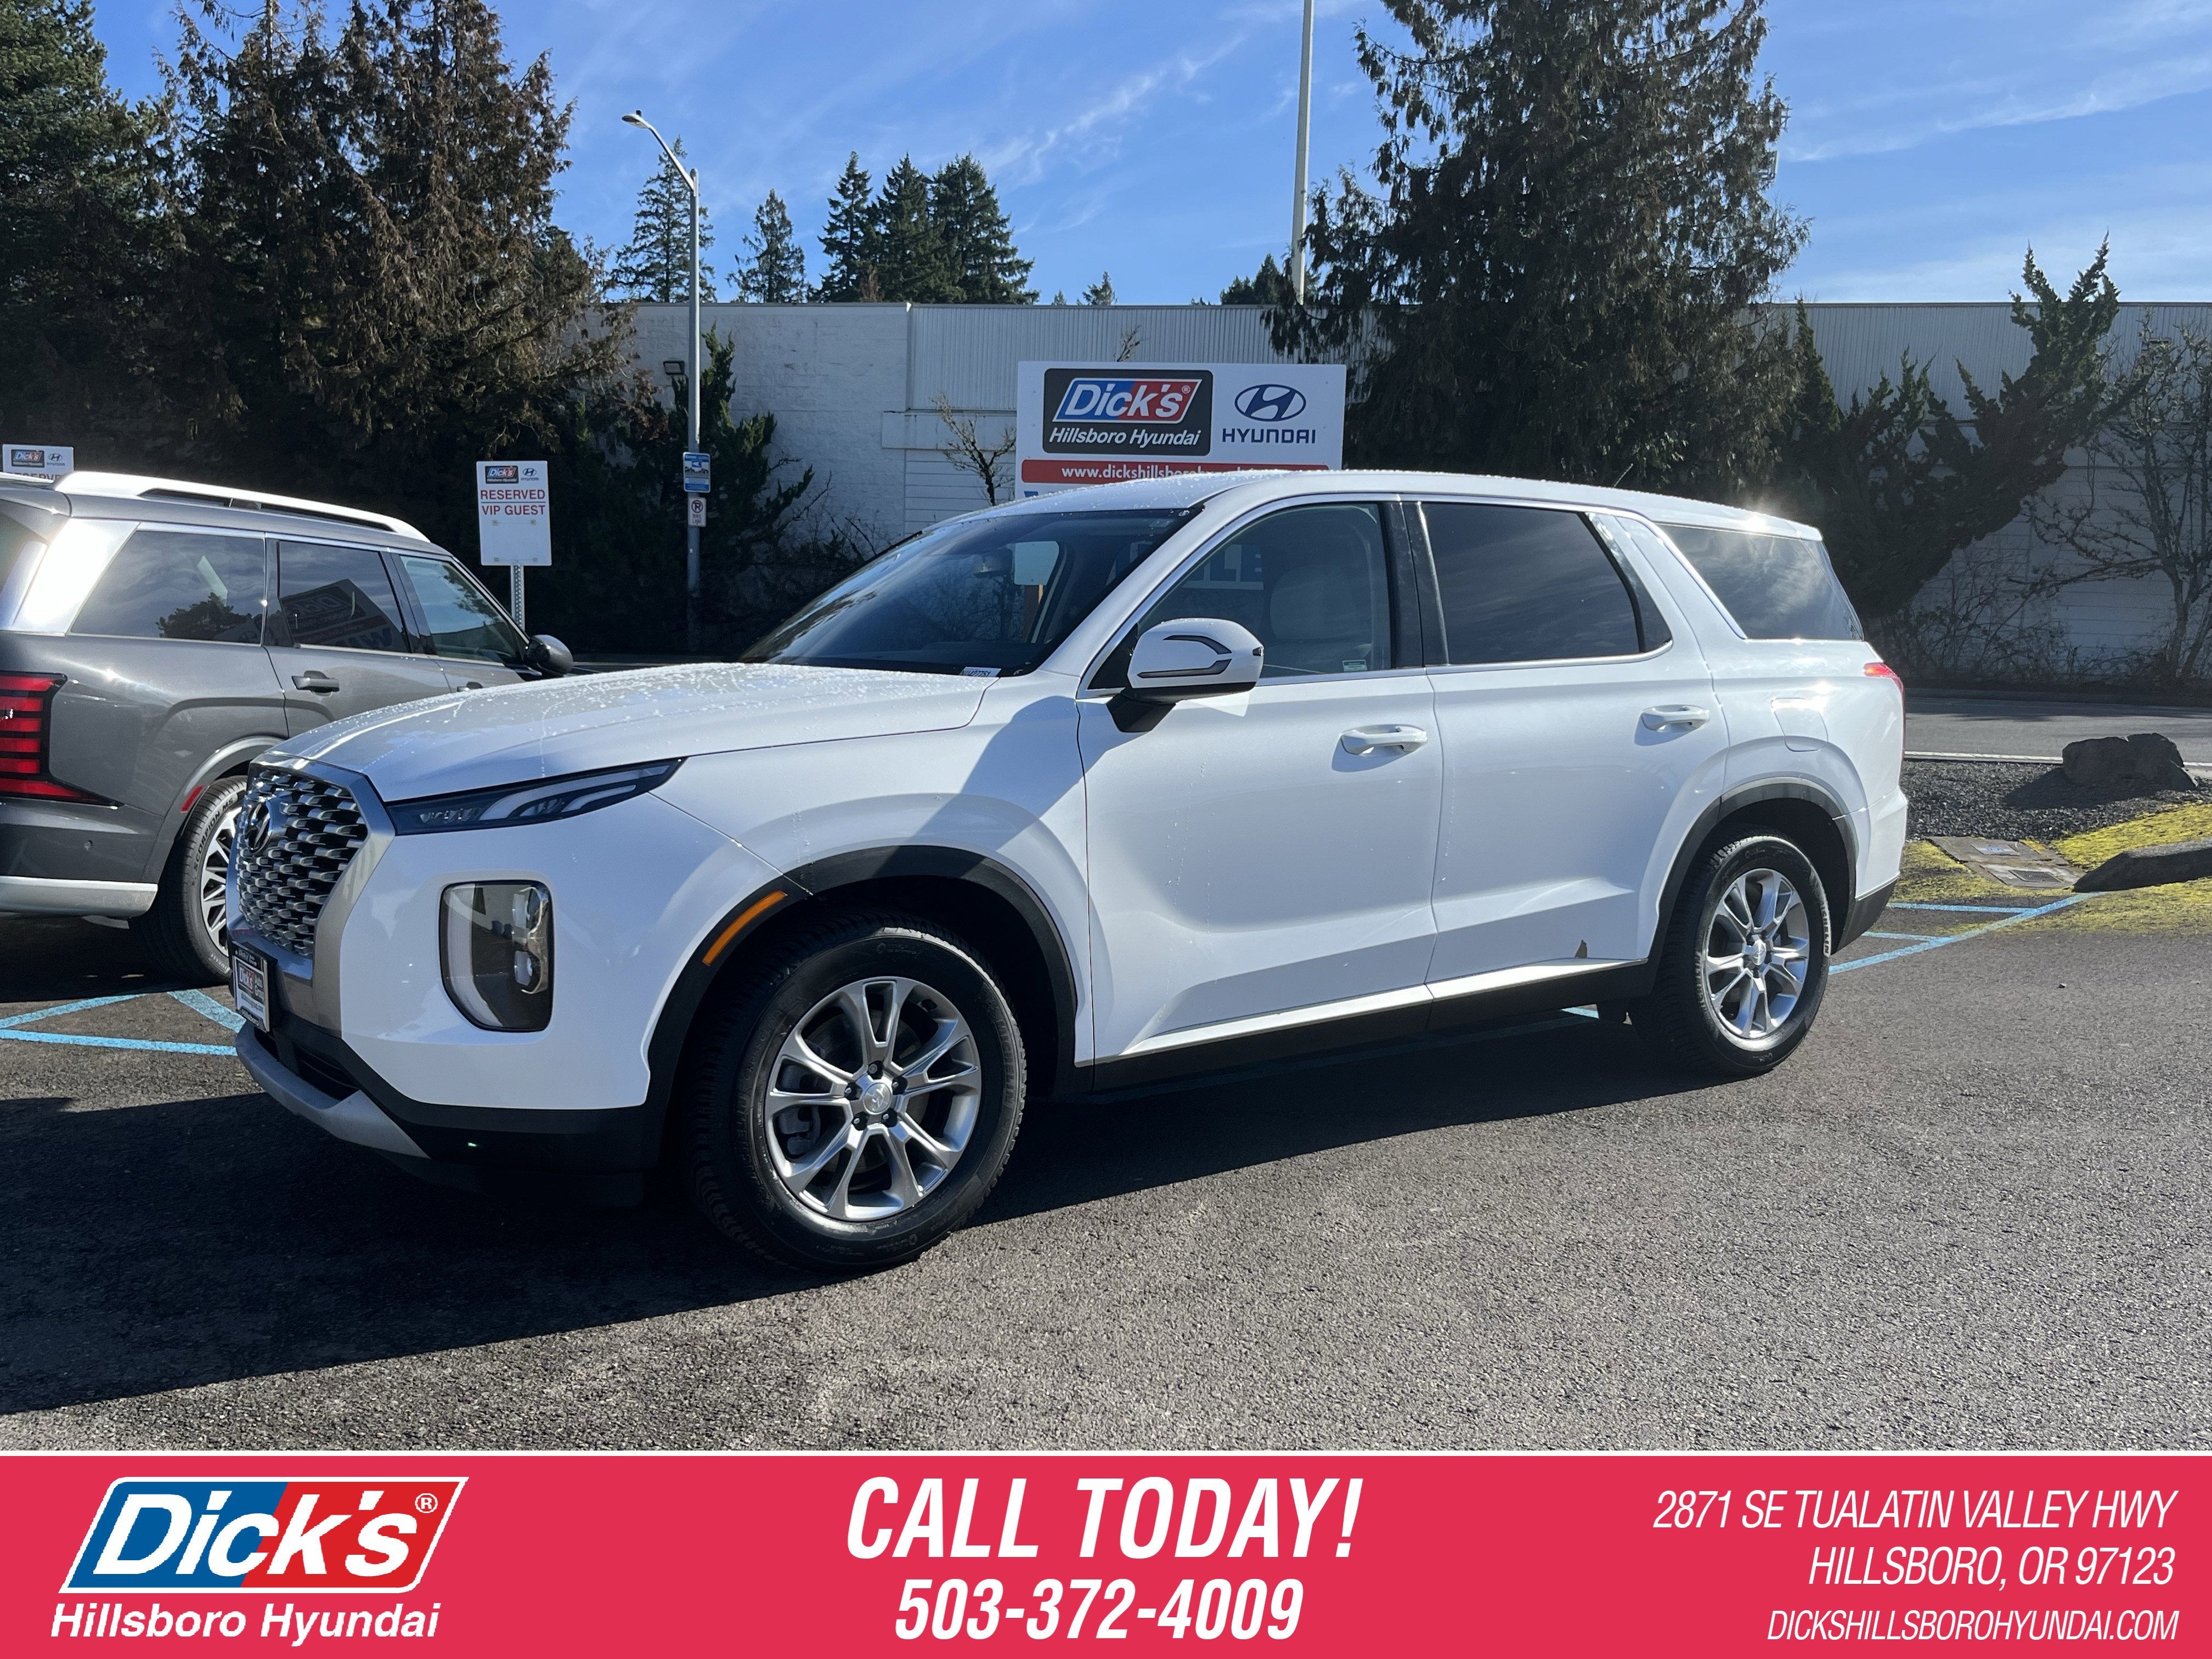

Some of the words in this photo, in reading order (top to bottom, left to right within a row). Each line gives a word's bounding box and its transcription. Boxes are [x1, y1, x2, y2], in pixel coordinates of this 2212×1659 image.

[1065, 383, 1183, 419] Dick's
[1049, 427, 1126, 445] Hillsboro
[1130, 429, 1201, 448] Hyundai
[1222, 428, 1316, 444] HYUNDAI
[481, 489, 545, 500] RESERVED
[482, 505, 500, 515] VIP
[505, 505, 545, 515] GUEST
[194, 811, 220, 871] SCORPION
